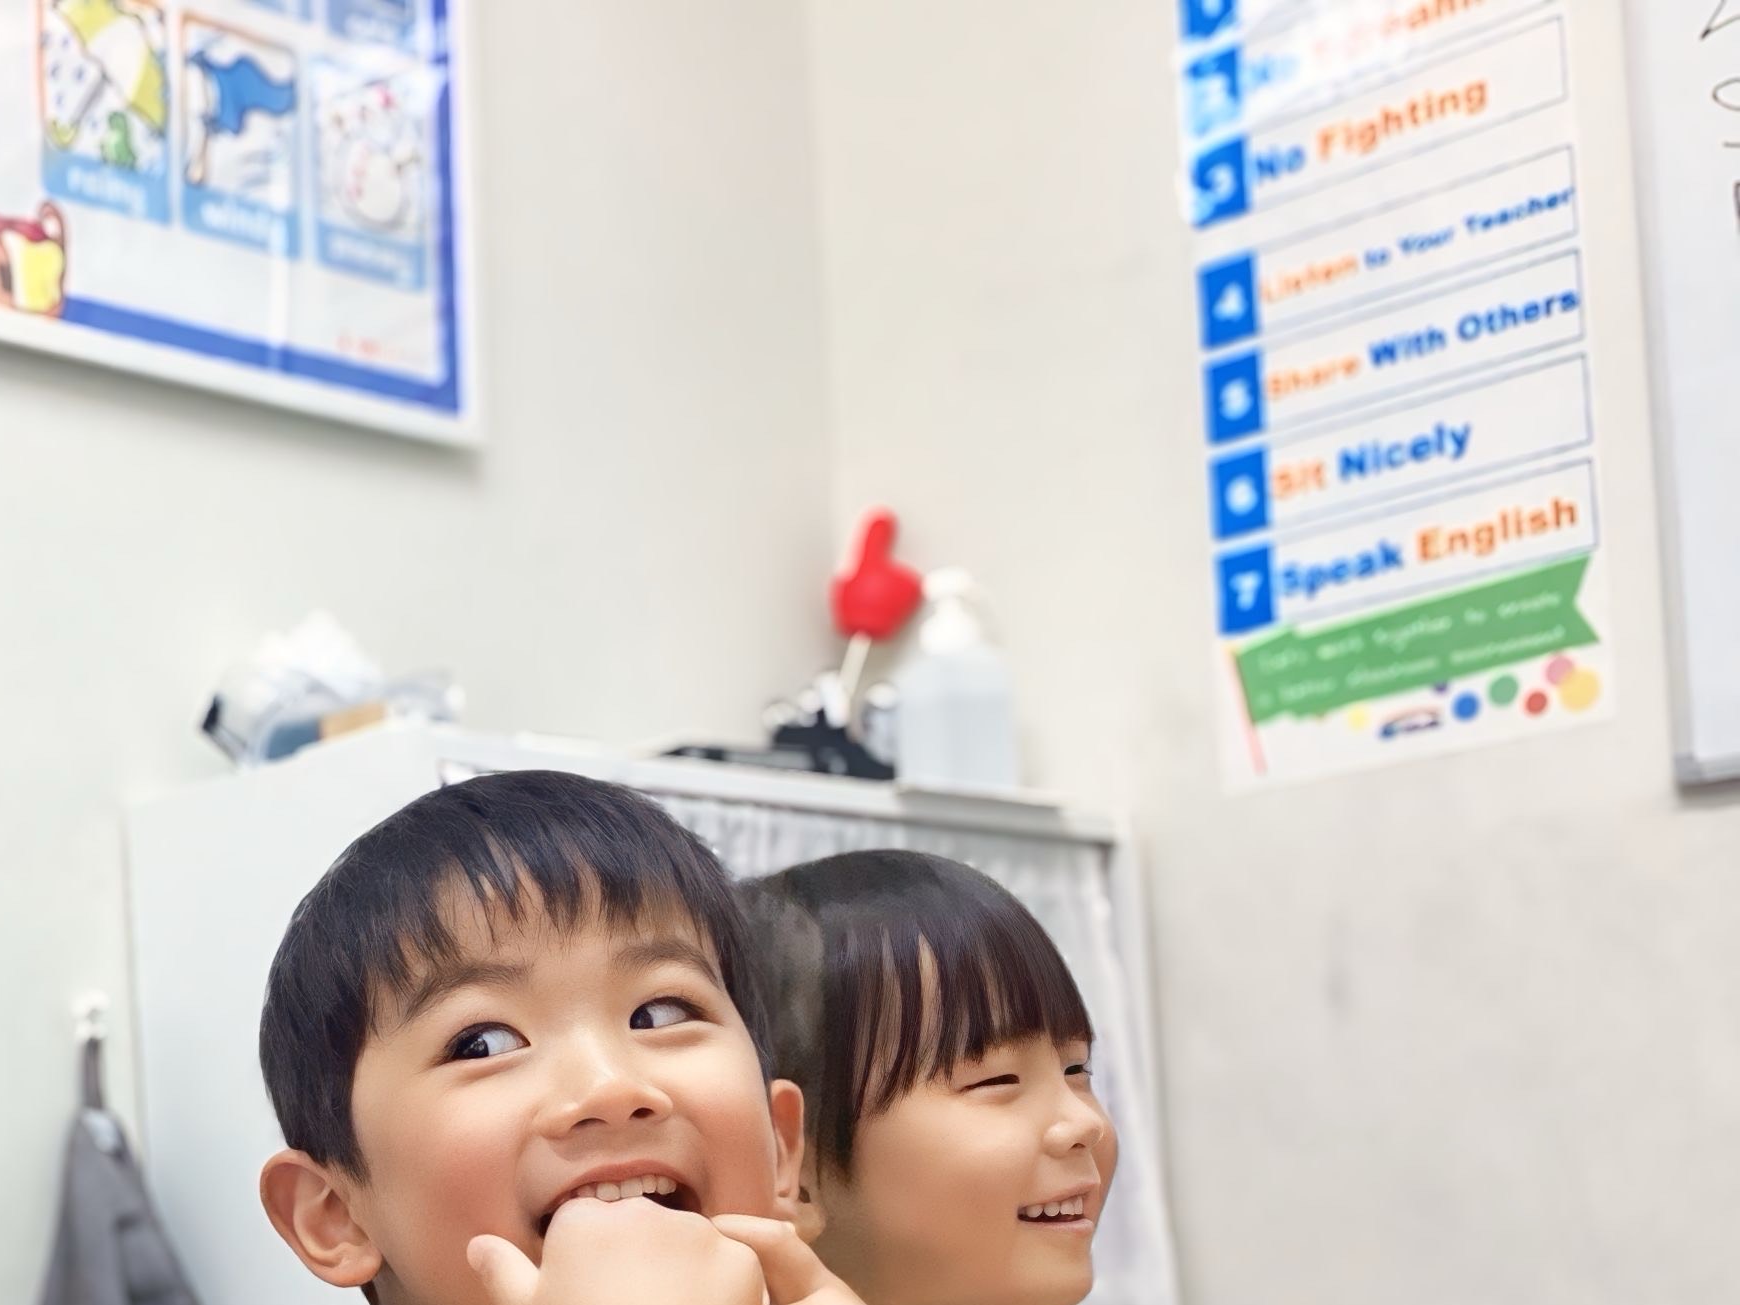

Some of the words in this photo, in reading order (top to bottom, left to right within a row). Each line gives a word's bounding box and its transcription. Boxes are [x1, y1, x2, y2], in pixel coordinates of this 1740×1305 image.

[1253, 146, 1304, 182] No
[1318, 78, 1487, 161] Fighting
[1212, 281, 1247, 321] 4
[1261, 254, 1358, 303] Listen
[1364, 247, 1391, 267] to
[1398, 227, 1456, 256] Your
[1465, 187, 1575, 235] Teacher
[1267, 354, 1360, 398] Share
[1369, 326, 1446, 368] With
[1457, 288, 1581, 342] Others
[1272, 460, 1327, 499] Sit
[1338, 421, 1471, 481] Nicely
[1230, 569, 1263, 610] 7
[1279, 539, 1403, 597] Speak
[1417, 498, 1578, 562] English
